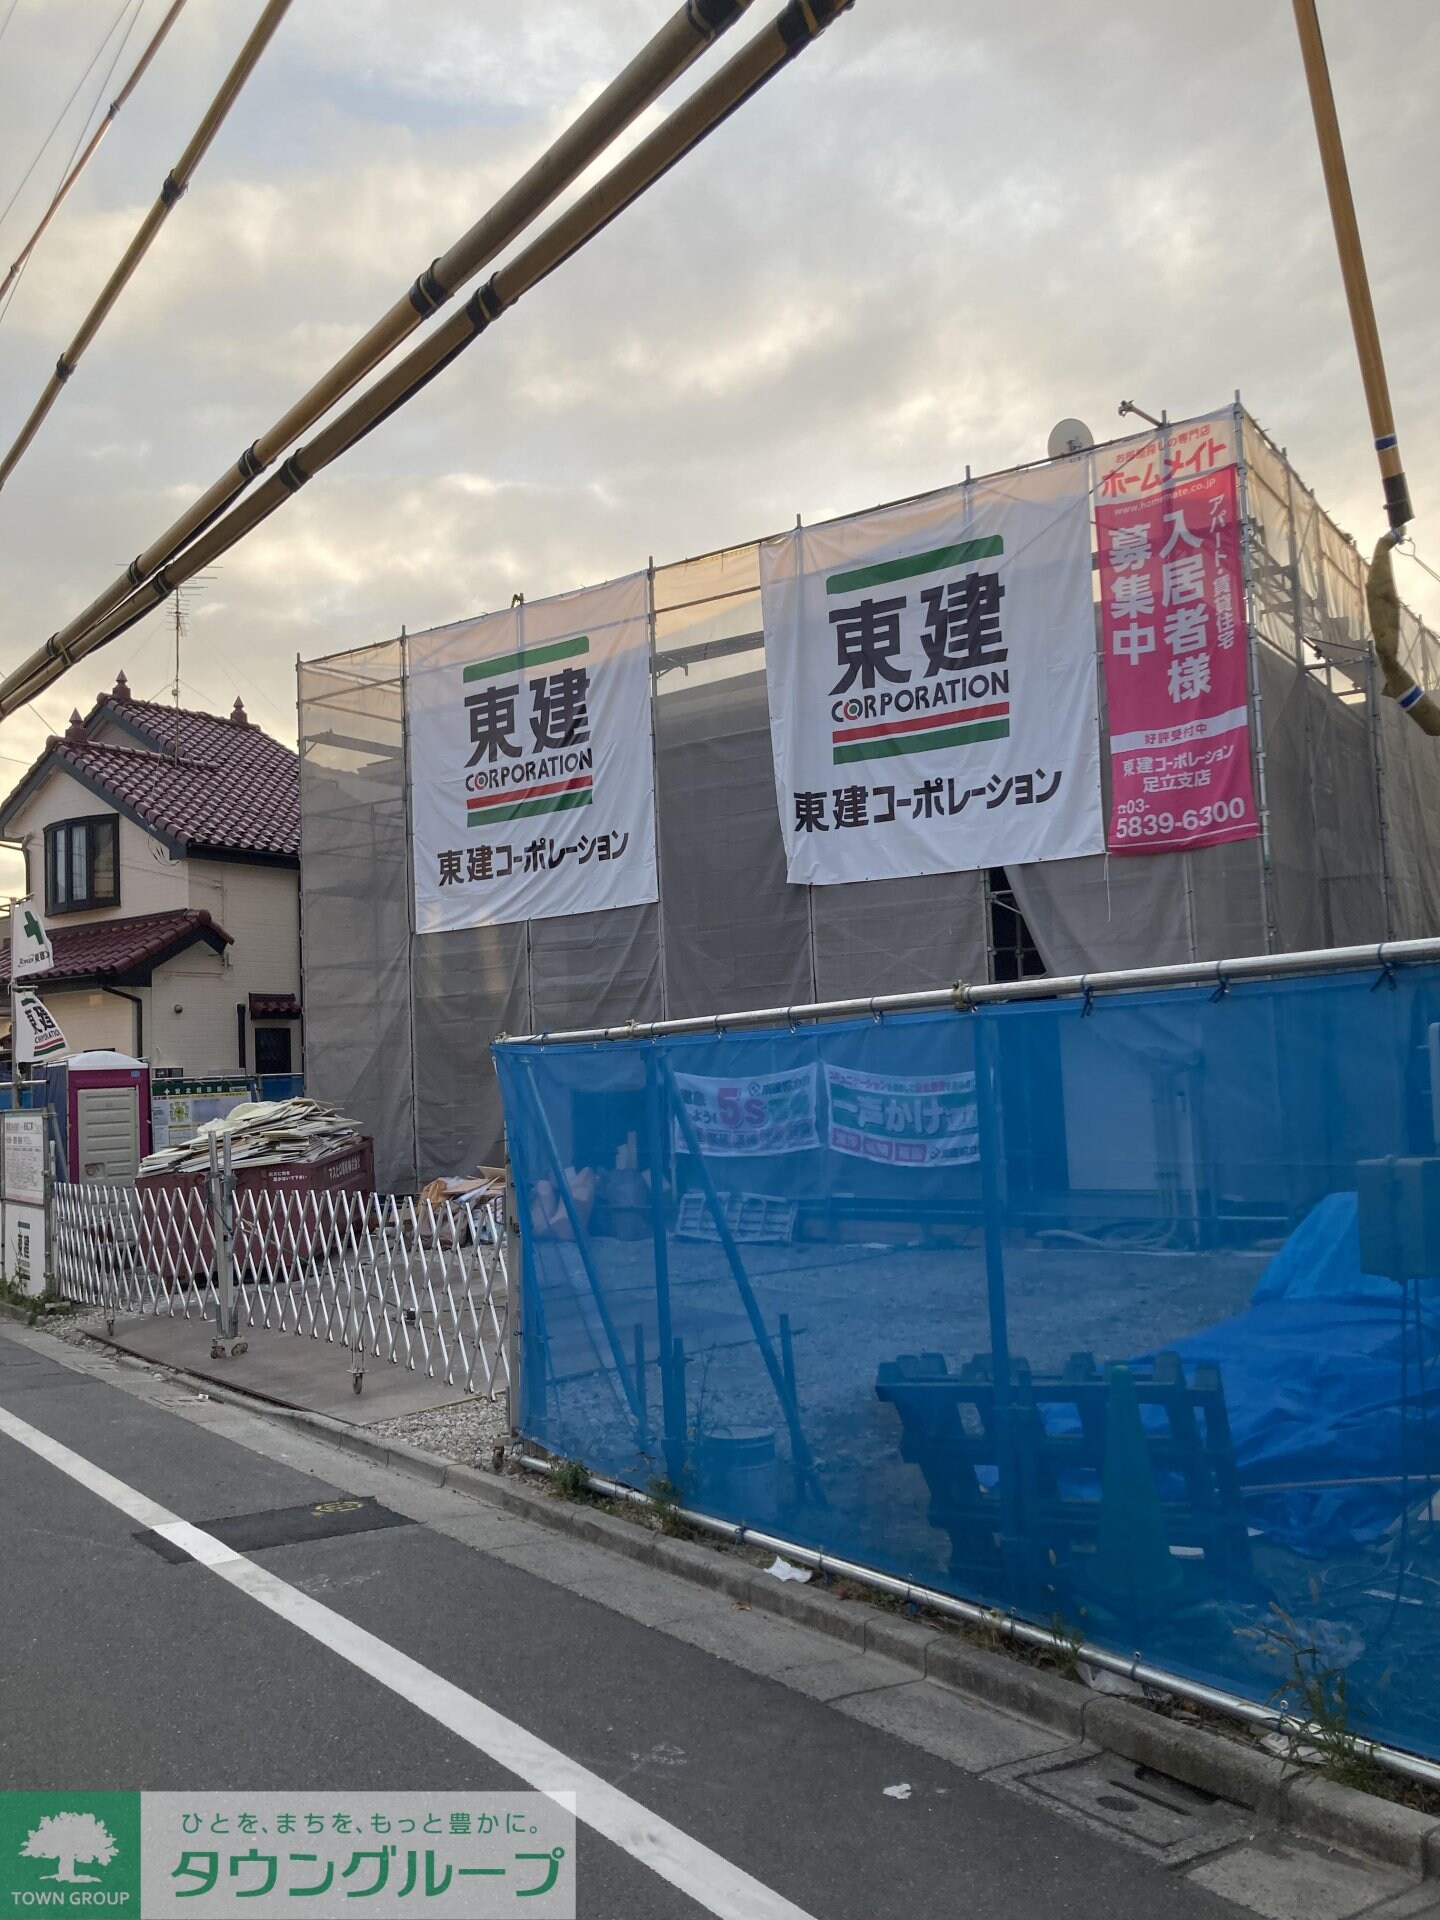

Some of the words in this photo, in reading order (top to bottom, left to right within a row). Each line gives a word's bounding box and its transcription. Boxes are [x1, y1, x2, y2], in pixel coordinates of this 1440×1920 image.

[1101, 438, 1227, 498] ホームメイト
[1115, 424, 1210, 464] お部屋探しの専門店
[1114, 477, 1216, 516] www.homemate.co.jp
[1108, 522, 1156, 666] 募集中
[1209, 493, 1234, 650] アパート・賃貸住宅
[1158, 509, 1211, 703] 入居者様
[828, 572, 1009, 696] 東建
[464, 668, 591, 769] 東建
[831, 669, 1010, 723] CORPORATION
[1122, 744, 1235, 778] 東建コーポレーション
[1144, 723, 1207, 745] 好評受付中
[465, 748, 593, 792] CORPORATION
[1142, 769, 1212, 794] 足立支店
[793, 768, 1063, 833] 東建コーポレーション
[1115, 796, 1245, 839] 5839-6300
[437, 831, 630, 887] 東建コーポレーション
